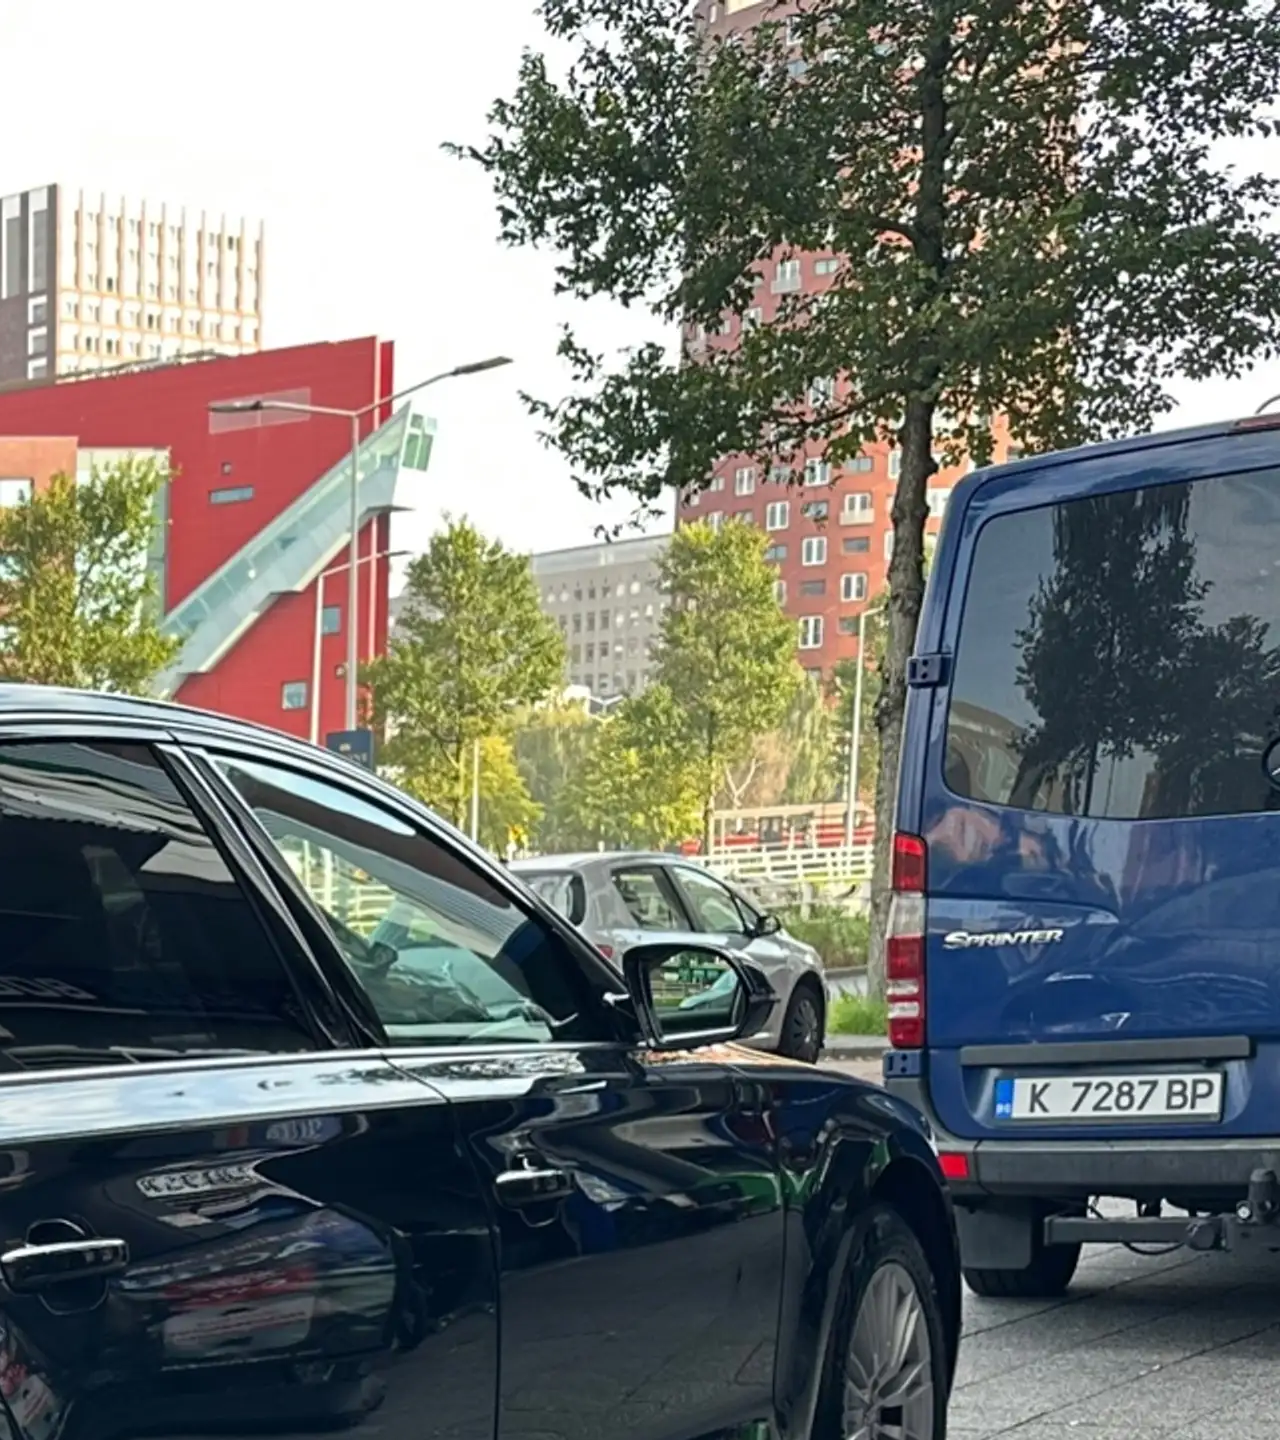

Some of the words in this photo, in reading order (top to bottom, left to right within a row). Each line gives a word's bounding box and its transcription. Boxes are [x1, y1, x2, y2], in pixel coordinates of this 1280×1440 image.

[942, 929, 1064, 949] SPRINTER
[1029, 1082, 1051, 1113] K
[1071, 1080, 1159, 1112] 7287
[1166, 1078, 1215, 1110] BP
